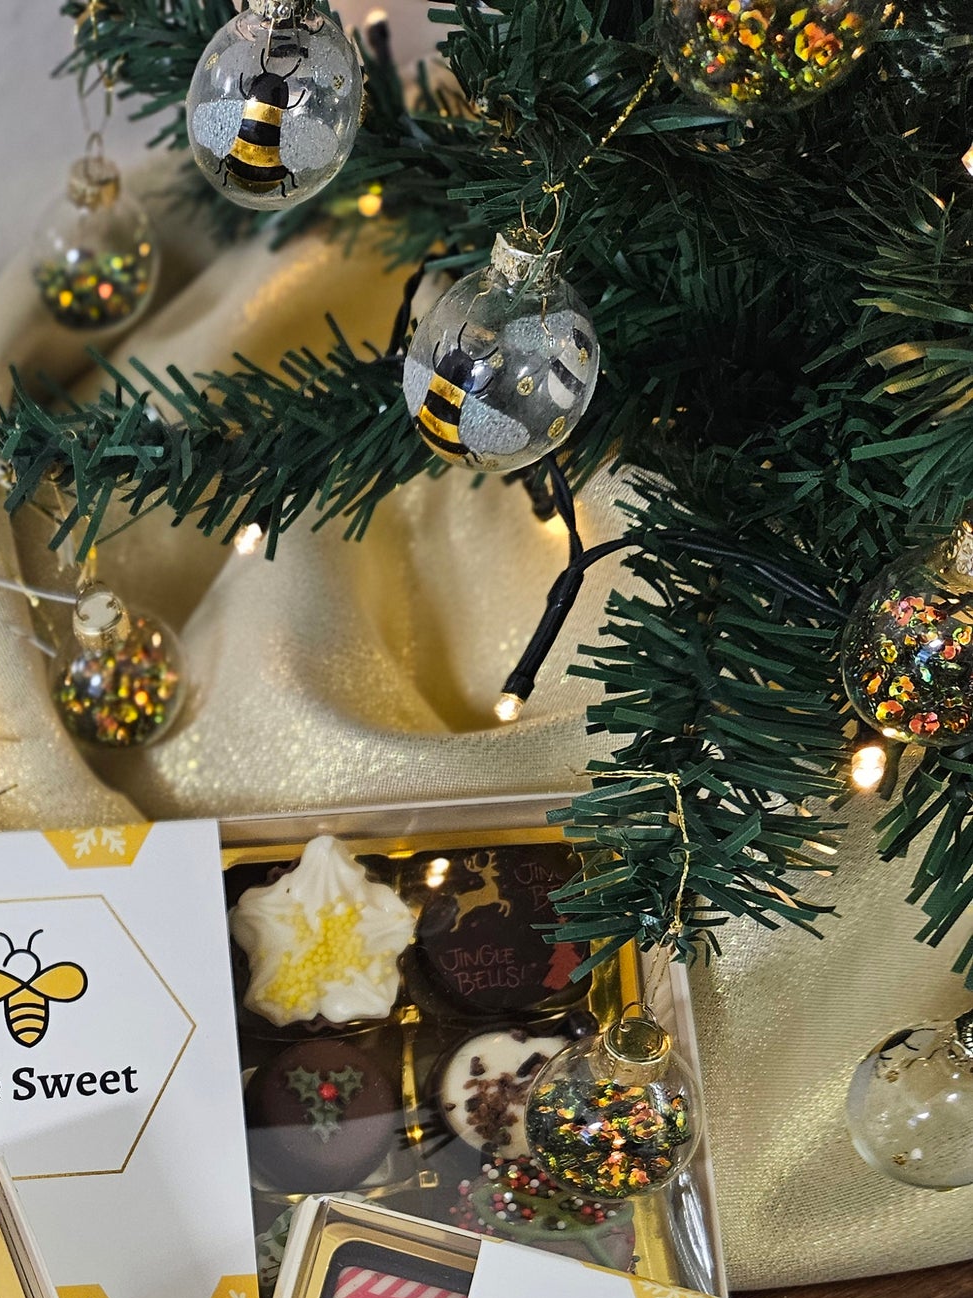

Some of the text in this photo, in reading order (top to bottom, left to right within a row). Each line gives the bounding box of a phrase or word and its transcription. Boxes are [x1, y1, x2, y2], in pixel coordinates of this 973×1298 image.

[439, 944, 516, 971] JINGLE
[454, 966, 526, 996] BELLS!
[12, 1066, 139, 1101] Sweet
